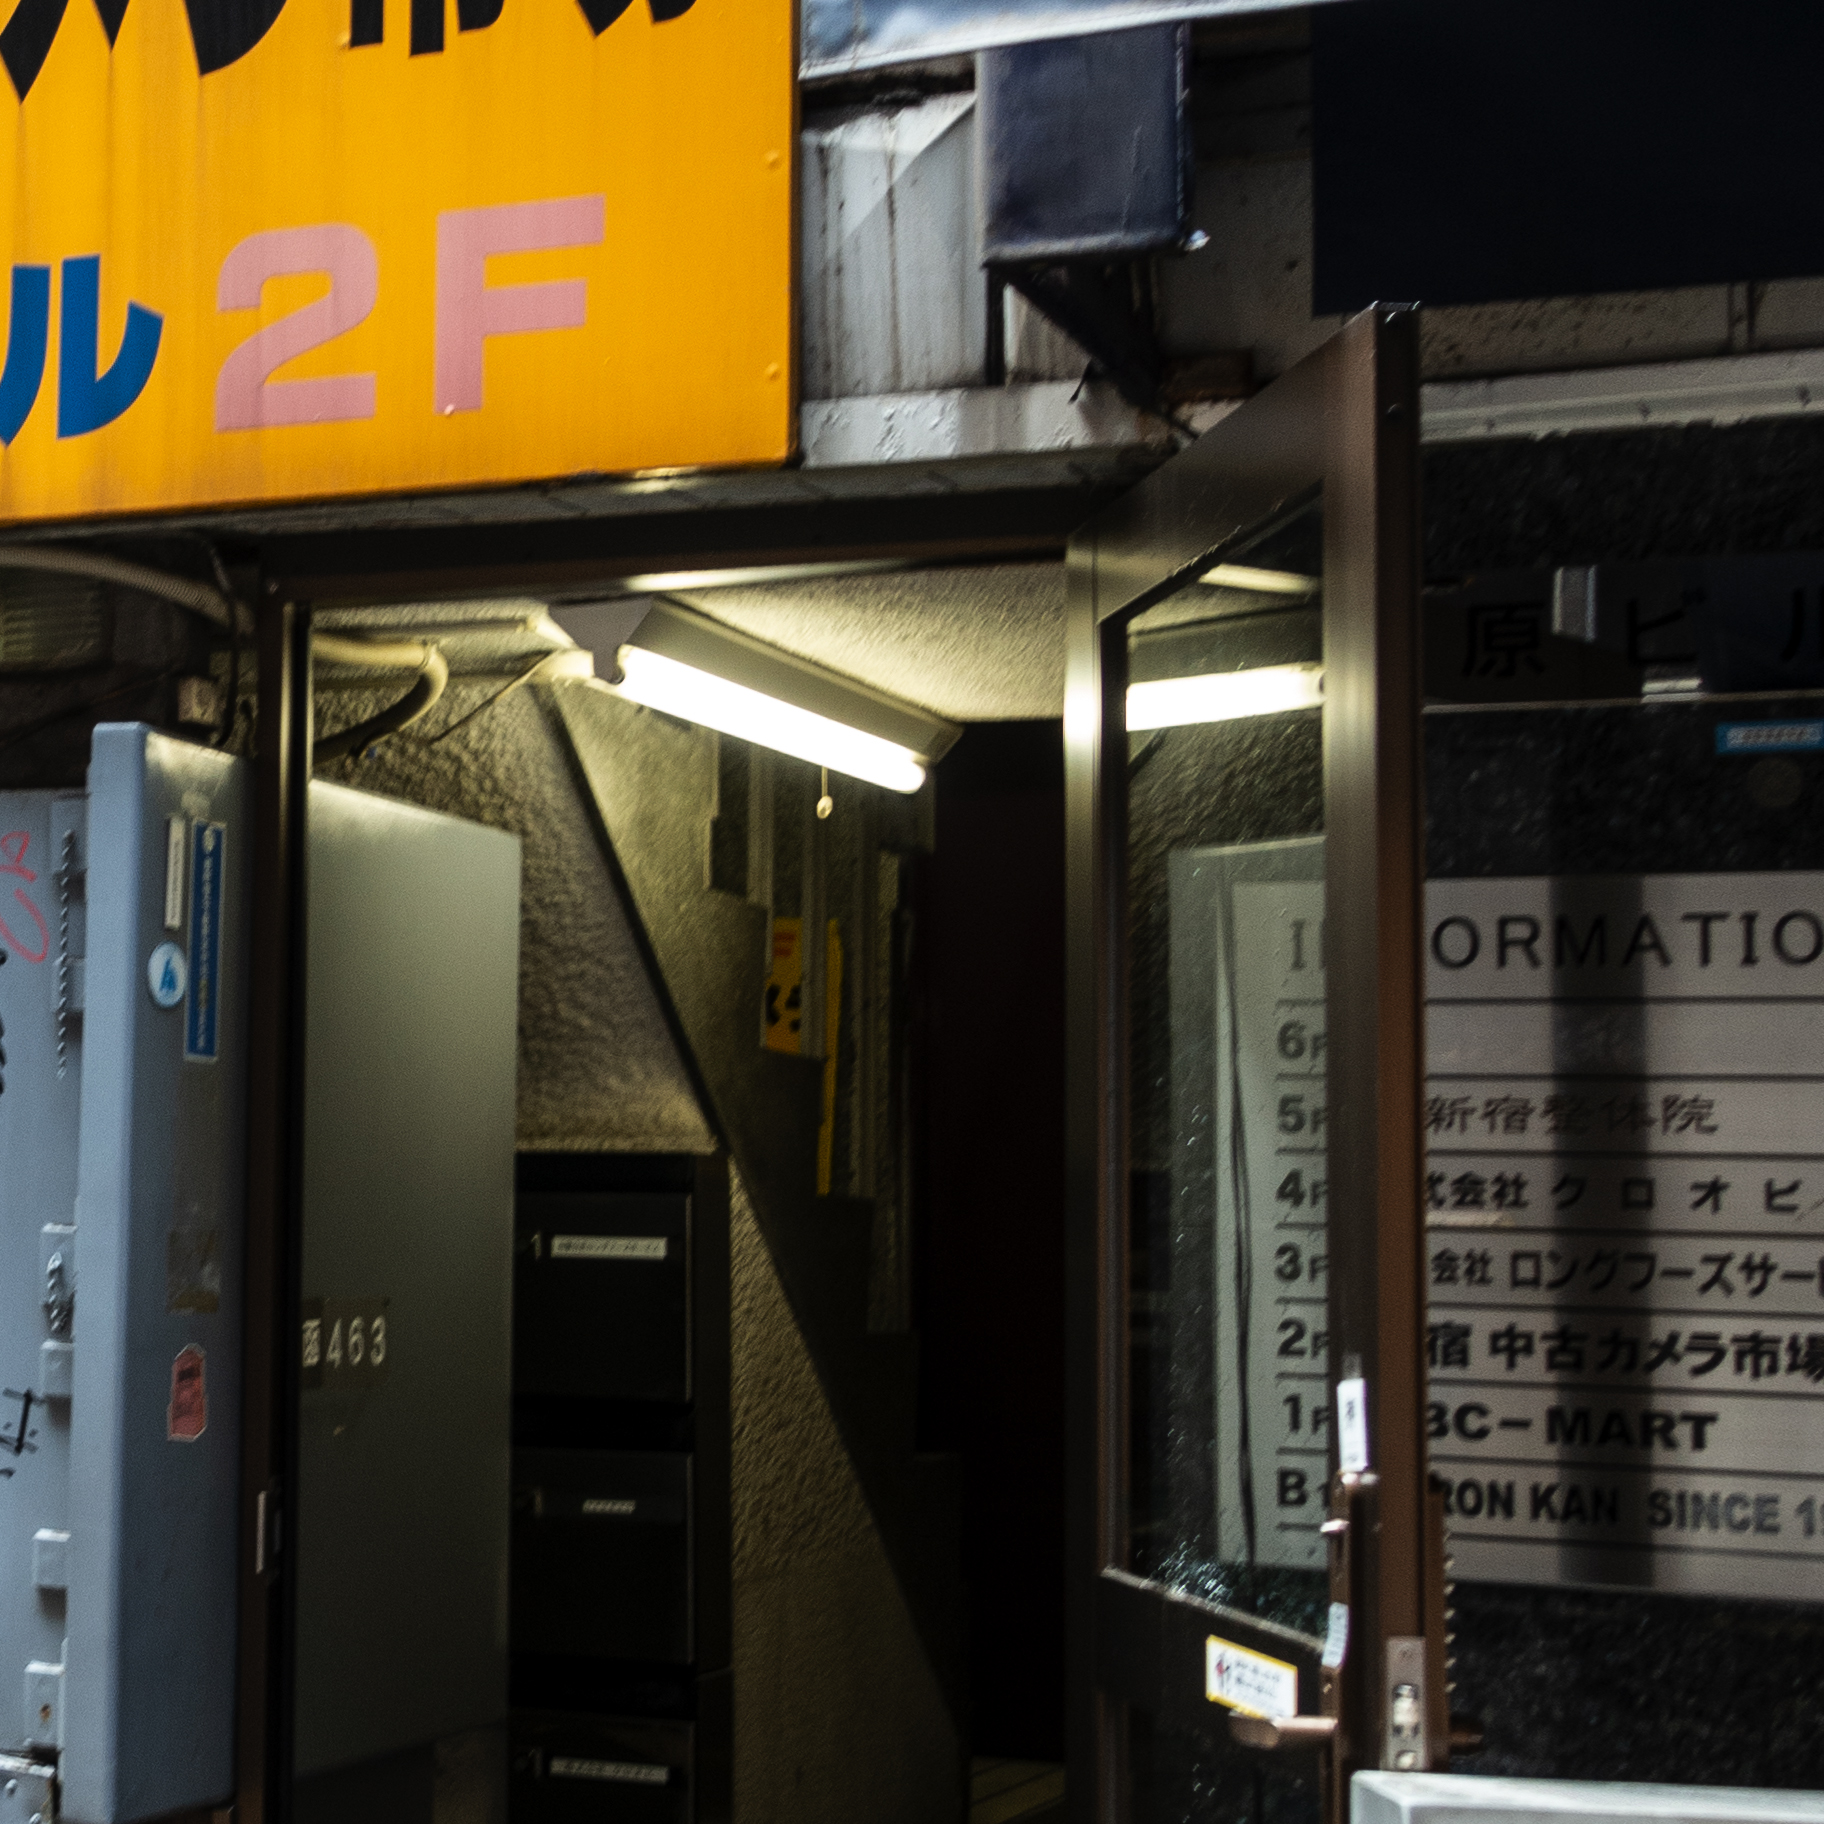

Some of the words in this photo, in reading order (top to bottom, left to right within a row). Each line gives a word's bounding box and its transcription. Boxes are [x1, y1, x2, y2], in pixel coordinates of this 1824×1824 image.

[1510, 1249, 1824, 1298] ロングフーズサー
[1647, 1490, 1781, 1535] SINCE
